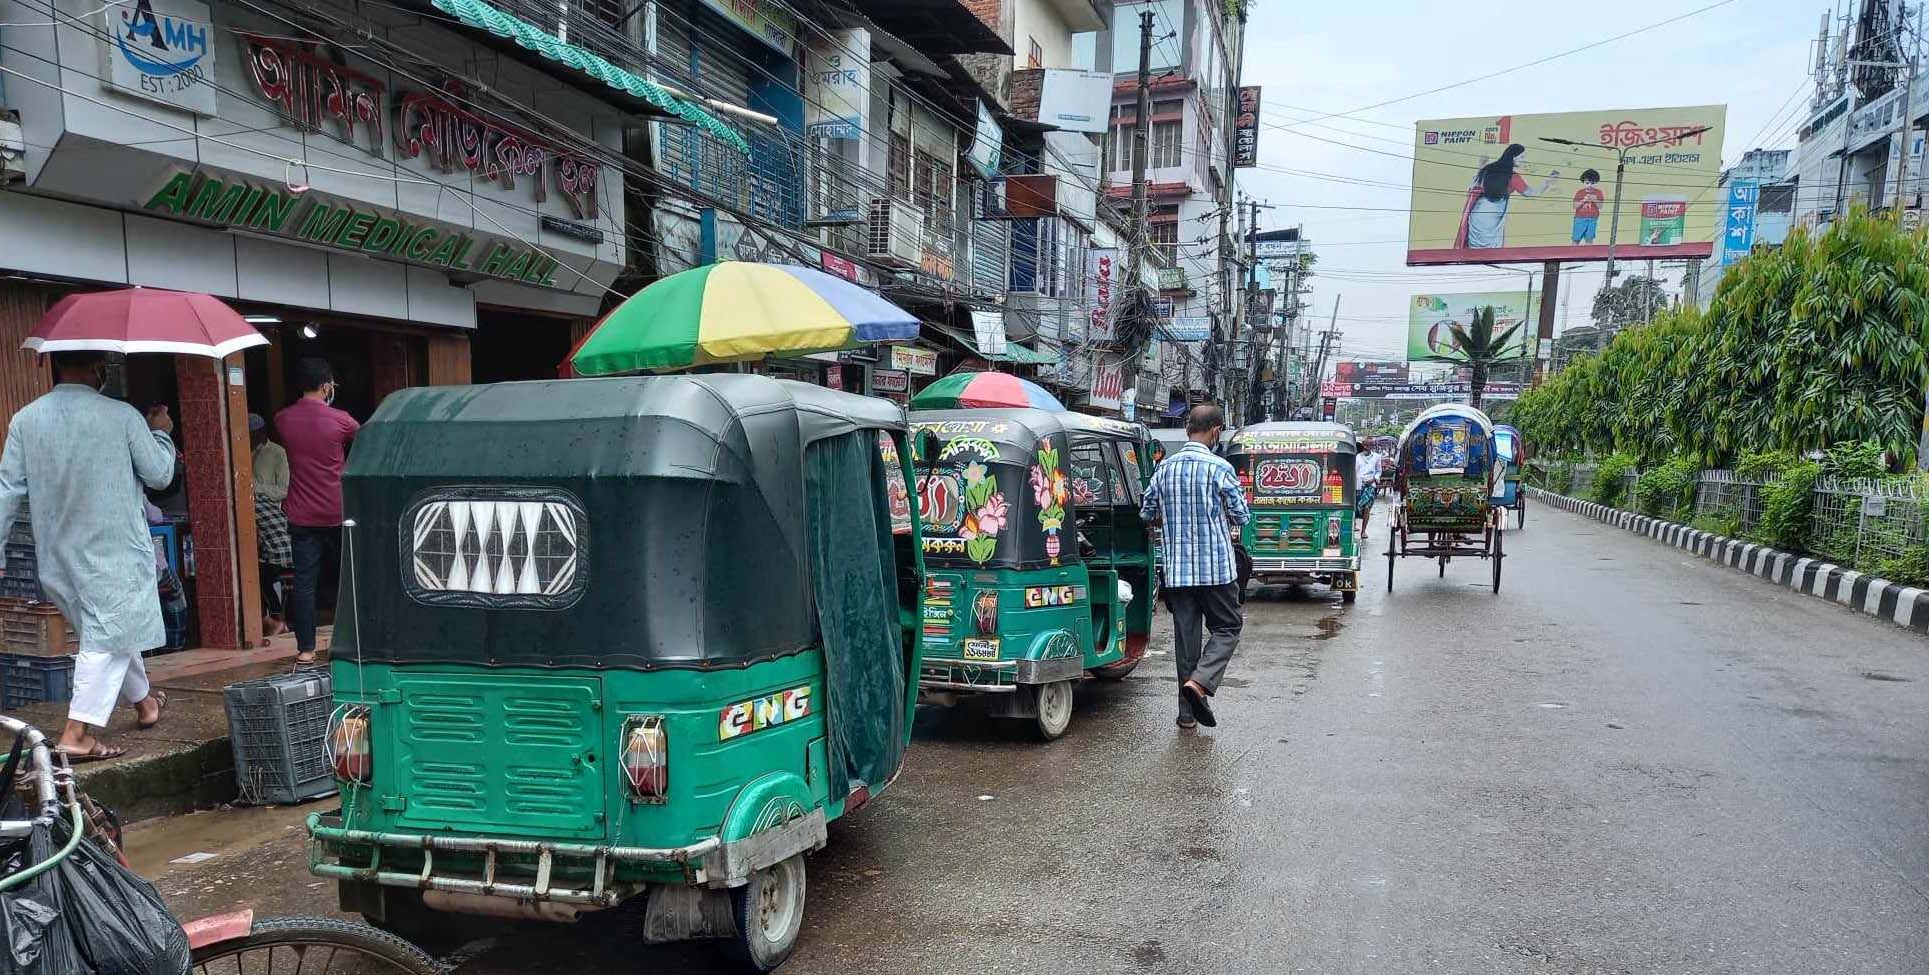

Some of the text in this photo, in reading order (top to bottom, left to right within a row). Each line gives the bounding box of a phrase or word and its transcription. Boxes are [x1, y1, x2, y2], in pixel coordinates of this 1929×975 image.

[240, 30, 386, 157] আমিন
[557, 148, 600, 219] হল
[1441, 130, 1476, 138] NIPPON
[1443, 136, 1473, 144] PAINT
[143, 171, 299, 233] AMIN
[300, 203, 475, 271] MEDICAL
[481, 244, 563, 287] HALL
[1261, 462, 1311, 488] الله
